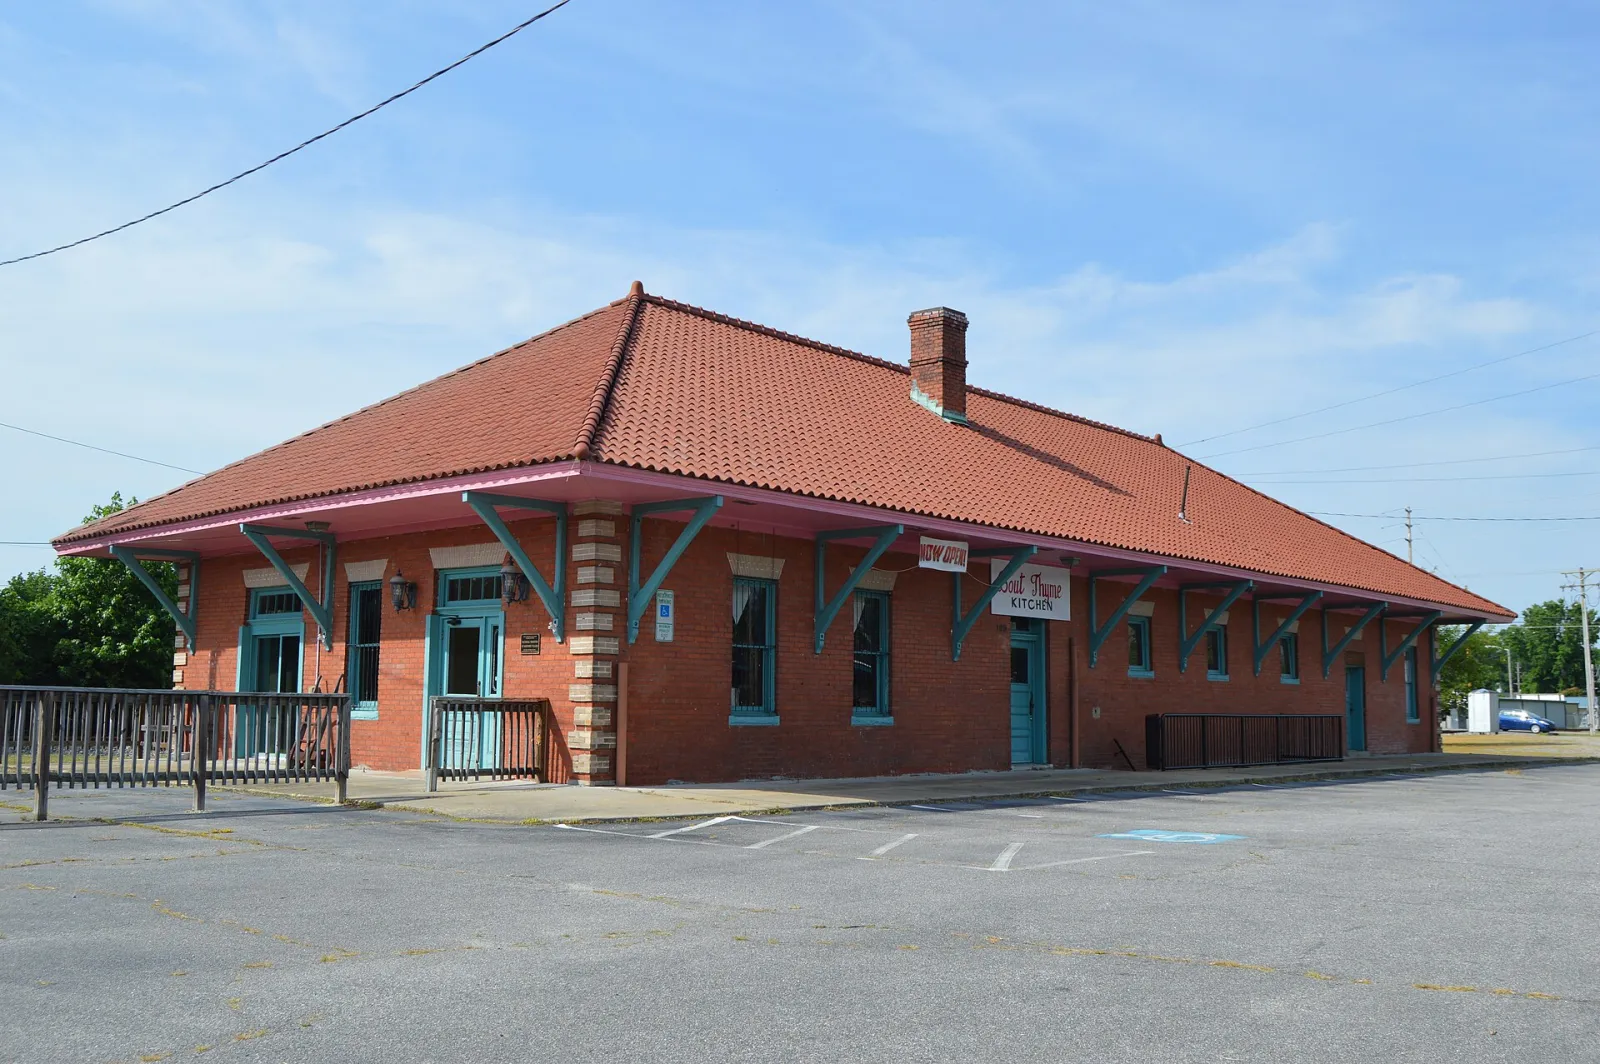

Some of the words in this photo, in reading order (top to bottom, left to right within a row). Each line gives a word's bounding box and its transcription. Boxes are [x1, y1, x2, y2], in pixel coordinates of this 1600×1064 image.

[920, 544, 945, 562] NOW
[942, 545, 967, 567] OPEN!
[1030, 572, 1062, 604] Thyme
[1011, 597, 1053, 611] KITCHEN
